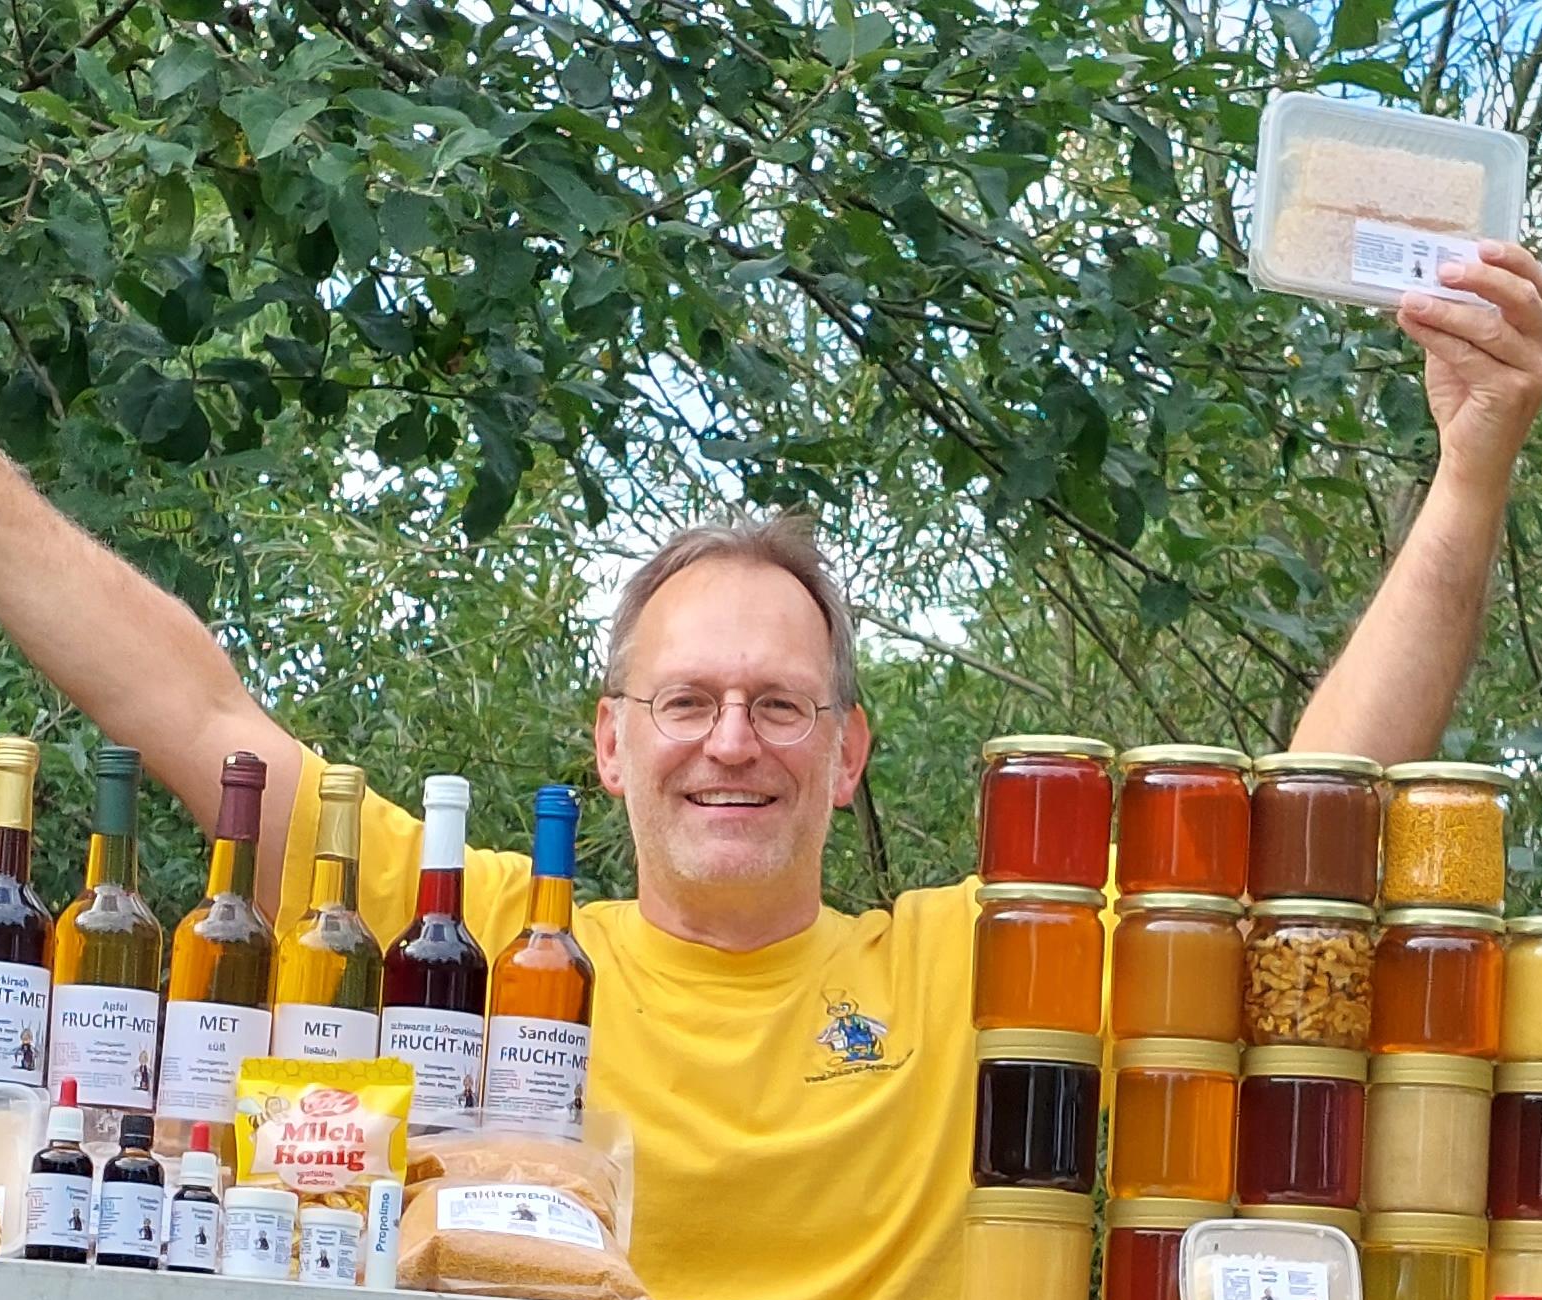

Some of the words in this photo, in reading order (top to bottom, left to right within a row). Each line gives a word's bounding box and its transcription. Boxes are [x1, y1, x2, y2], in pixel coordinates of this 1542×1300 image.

[102, 1000, 128, 1013] Apfel
[199, 1014, 240, 1034] MET
[304, 1021, 343, 1039] MET
[390, 1032, 483, 1059] FRUCHT-ME
[518, 1025, 587, 1048] Sanddorn
[499, 1046, 590, 1072] FRUCHT-ME
[282, 1120, 366, 1144] Milch
[273, 1144, 366, 1172] Honig
[375, 1192, 390, 1253] Propolino
